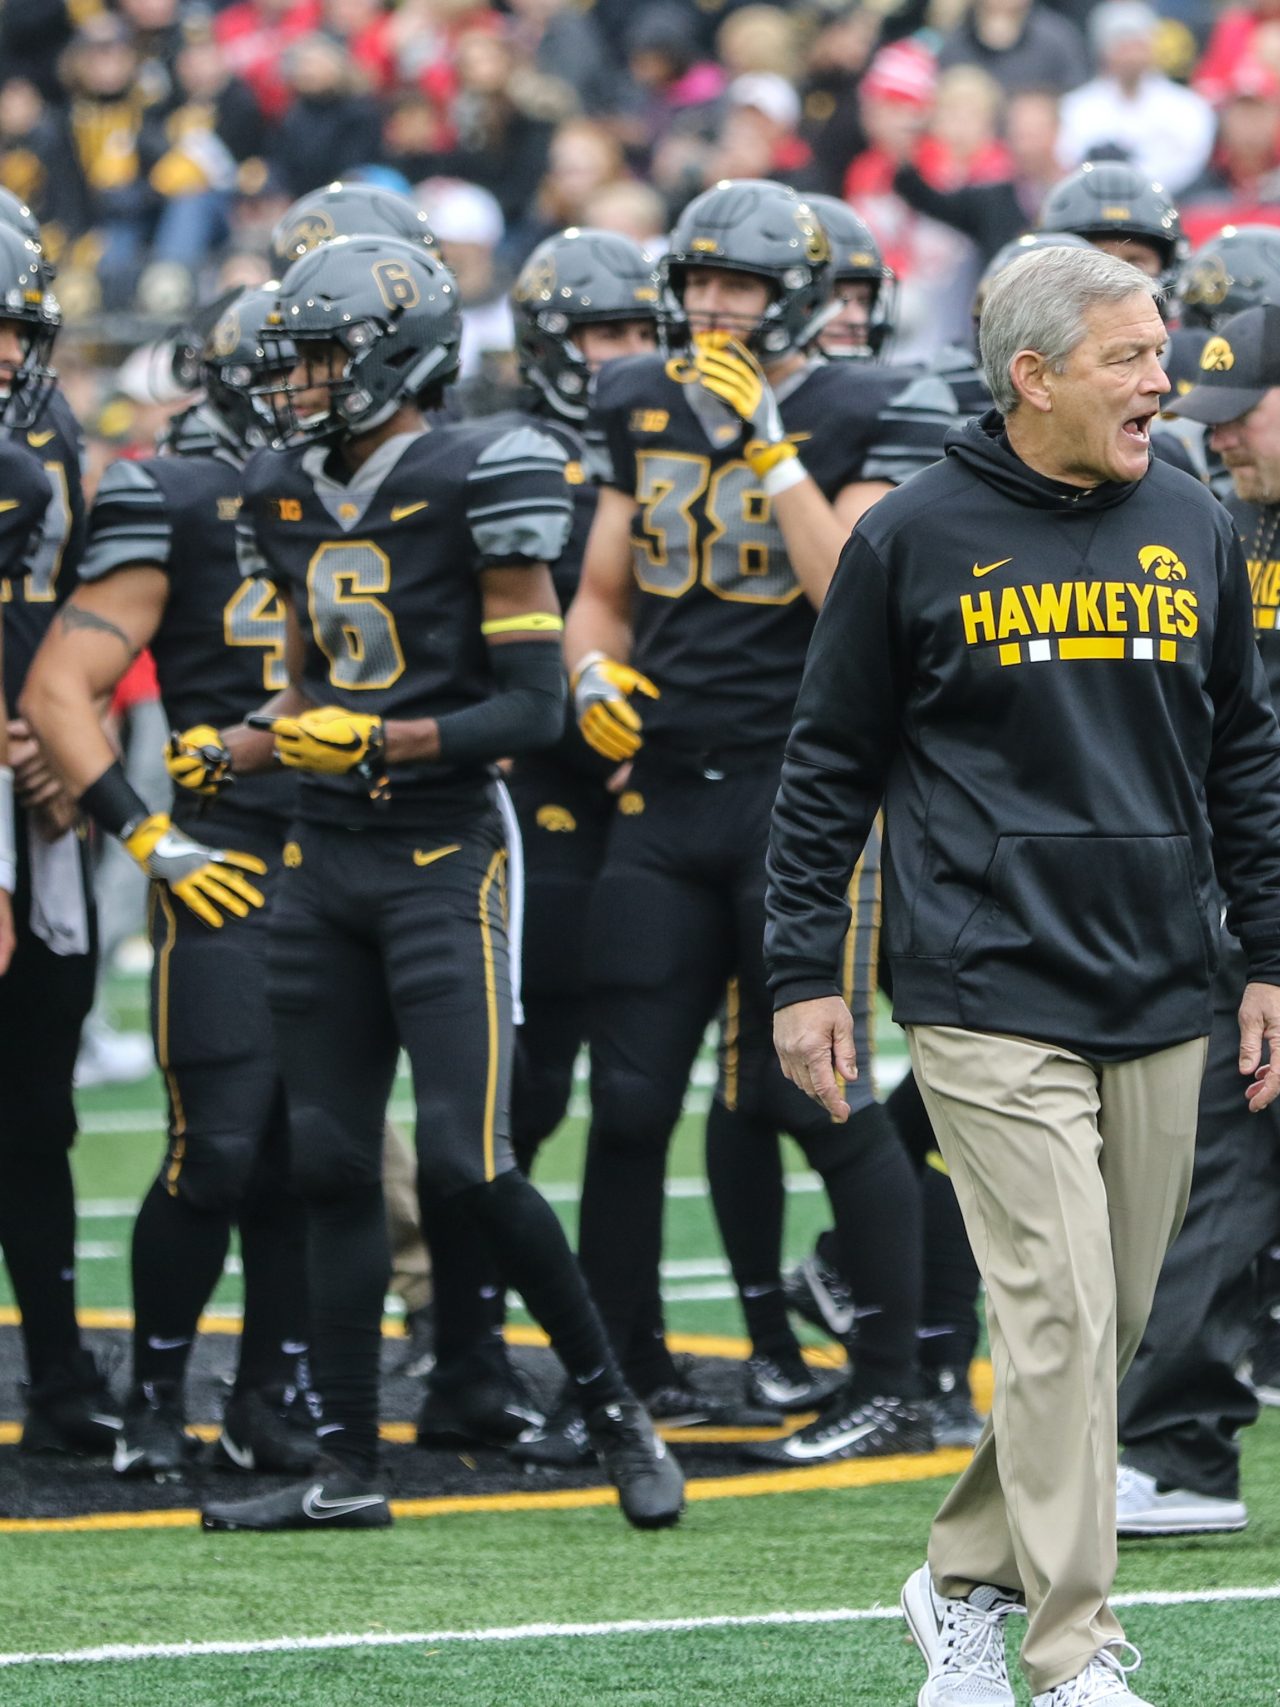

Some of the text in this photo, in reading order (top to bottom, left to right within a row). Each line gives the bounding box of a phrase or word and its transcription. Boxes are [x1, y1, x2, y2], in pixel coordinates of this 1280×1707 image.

[371, 259, 419, 312] 6
[630, 449, 804, 605] 38
[306, 540, 406, 690] 6
[960, 580, 1199, 646] HAWKEYES
